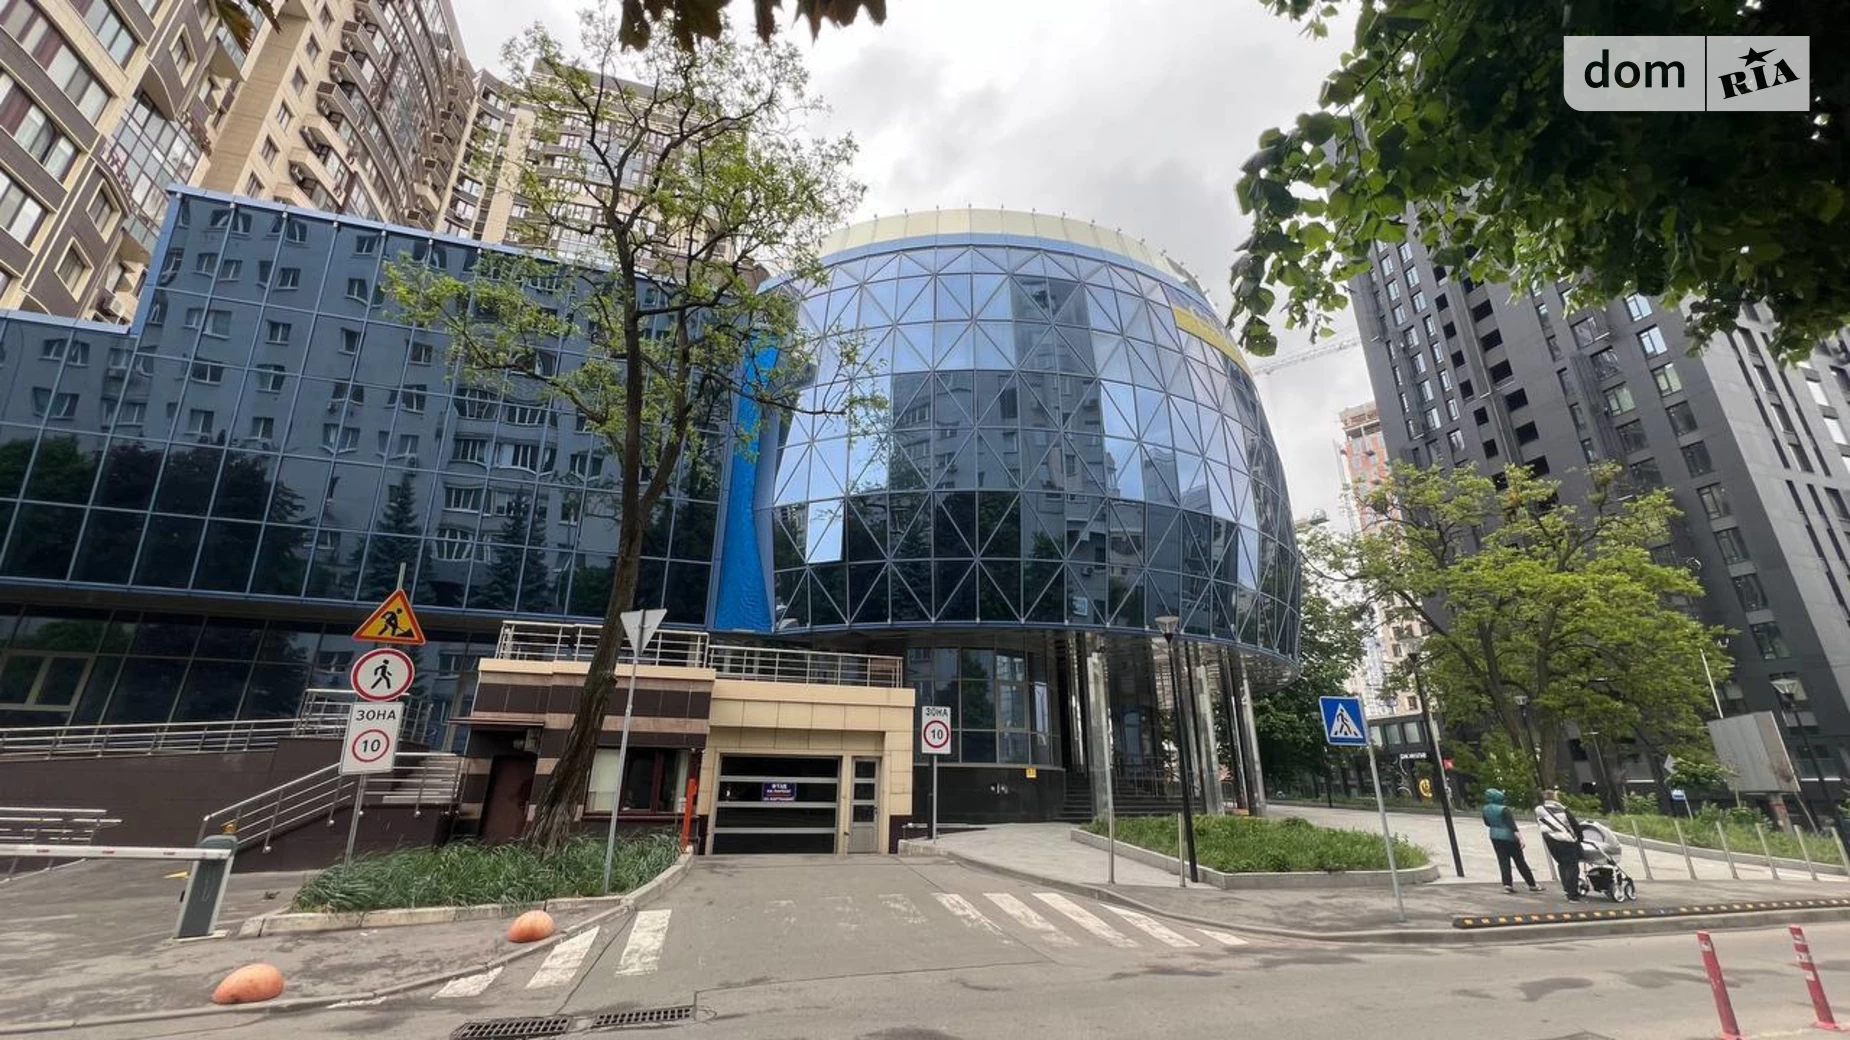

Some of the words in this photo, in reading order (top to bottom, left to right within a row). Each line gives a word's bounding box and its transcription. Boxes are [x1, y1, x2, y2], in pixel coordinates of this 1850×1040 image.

[356, 710, 396, 721] ЗОНА
[925, 707, 949, 717] ЗОНА
[931, 729, 943, 740] 10
[362, 739, 380, 752] 10
